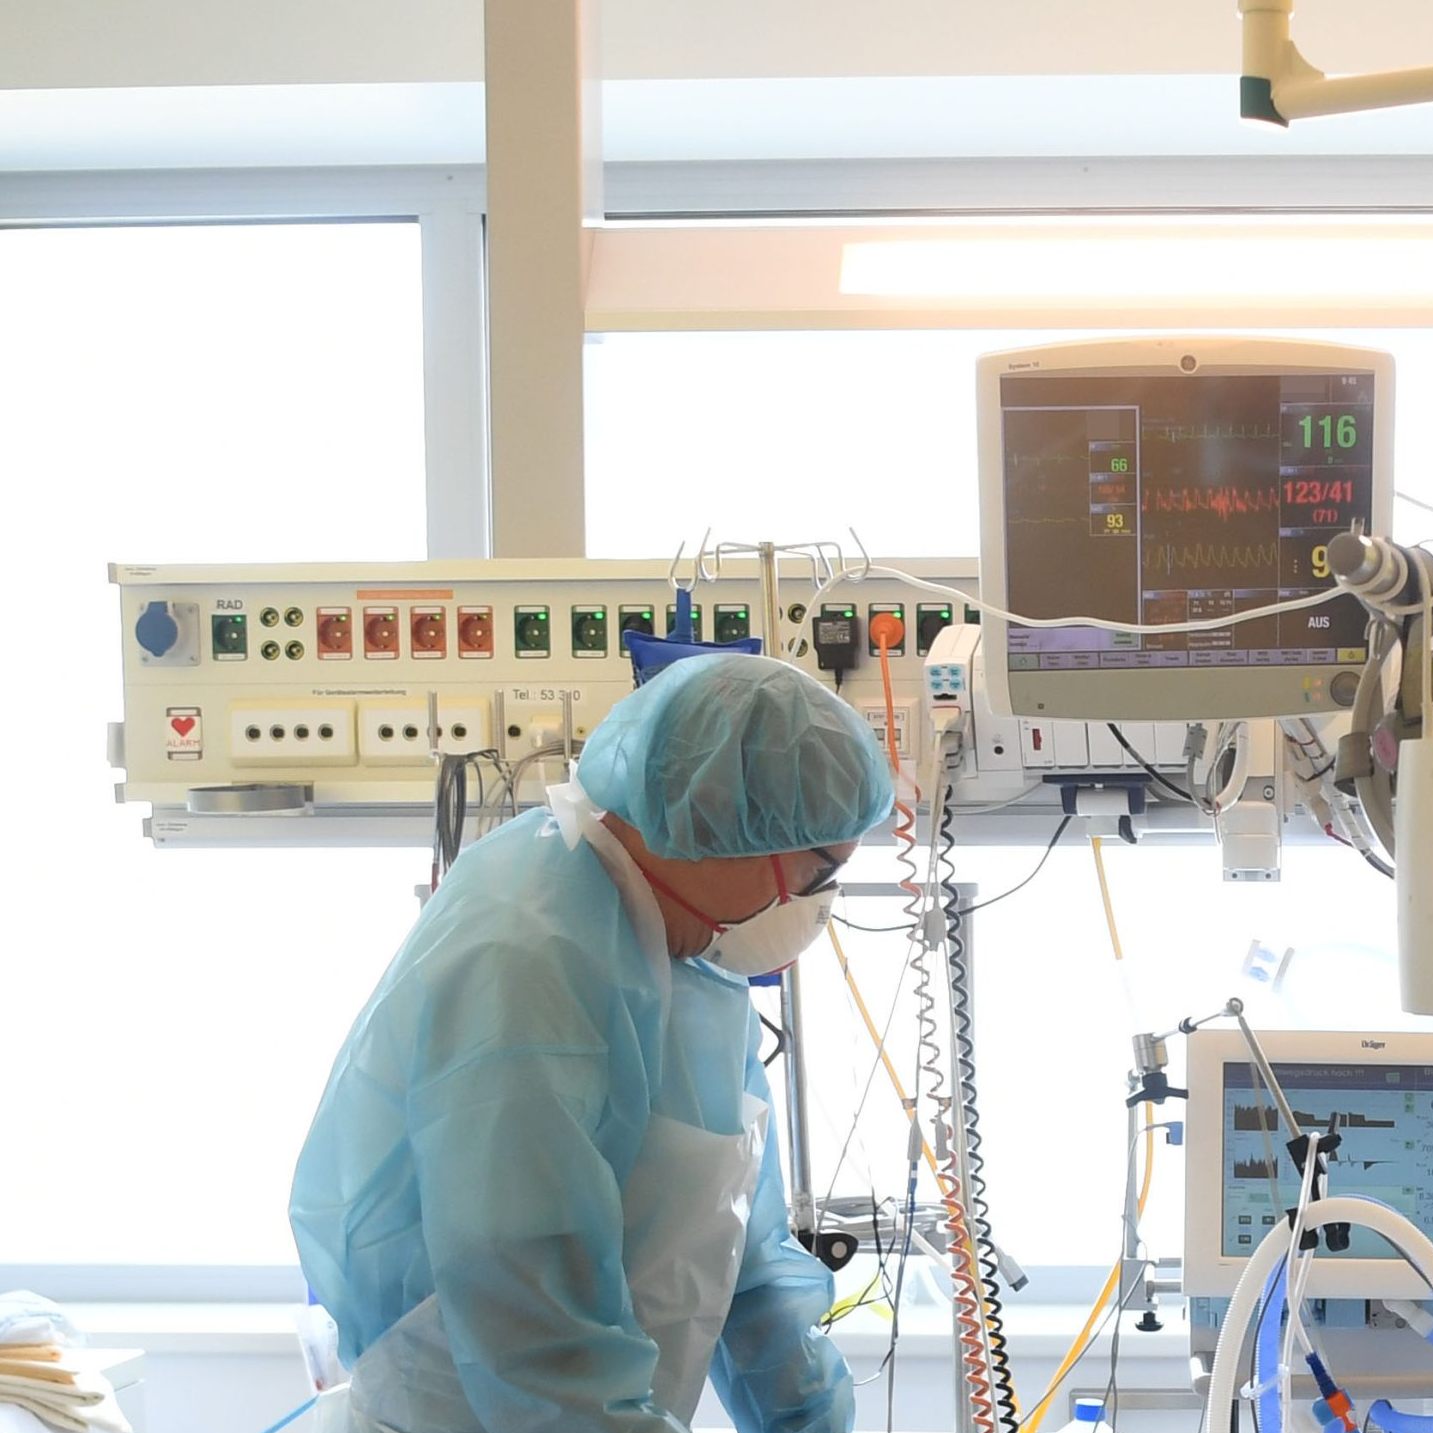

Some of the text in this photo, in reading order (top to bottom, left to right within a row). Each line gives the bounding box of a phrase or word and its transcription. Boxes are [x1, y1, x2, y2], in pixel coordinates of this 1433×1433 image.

[1298, 414, 1357, 449] 116
[1111, 458, 1128, 472] 66
[1284, 481, 1354, 503] 123/41
[1107, 513, 1124, 528] 93
[1312, 509, 1338, 523] (71)
[1311, 545, 1331, 578] 9
[216, 599, 243, 610] RAD
[1308, 617, 1330, 628] AUS
[540, 689, 555, 700] 53
[558, 690, 581, 701] 30
[167, 739, 201, 748] ALARM
